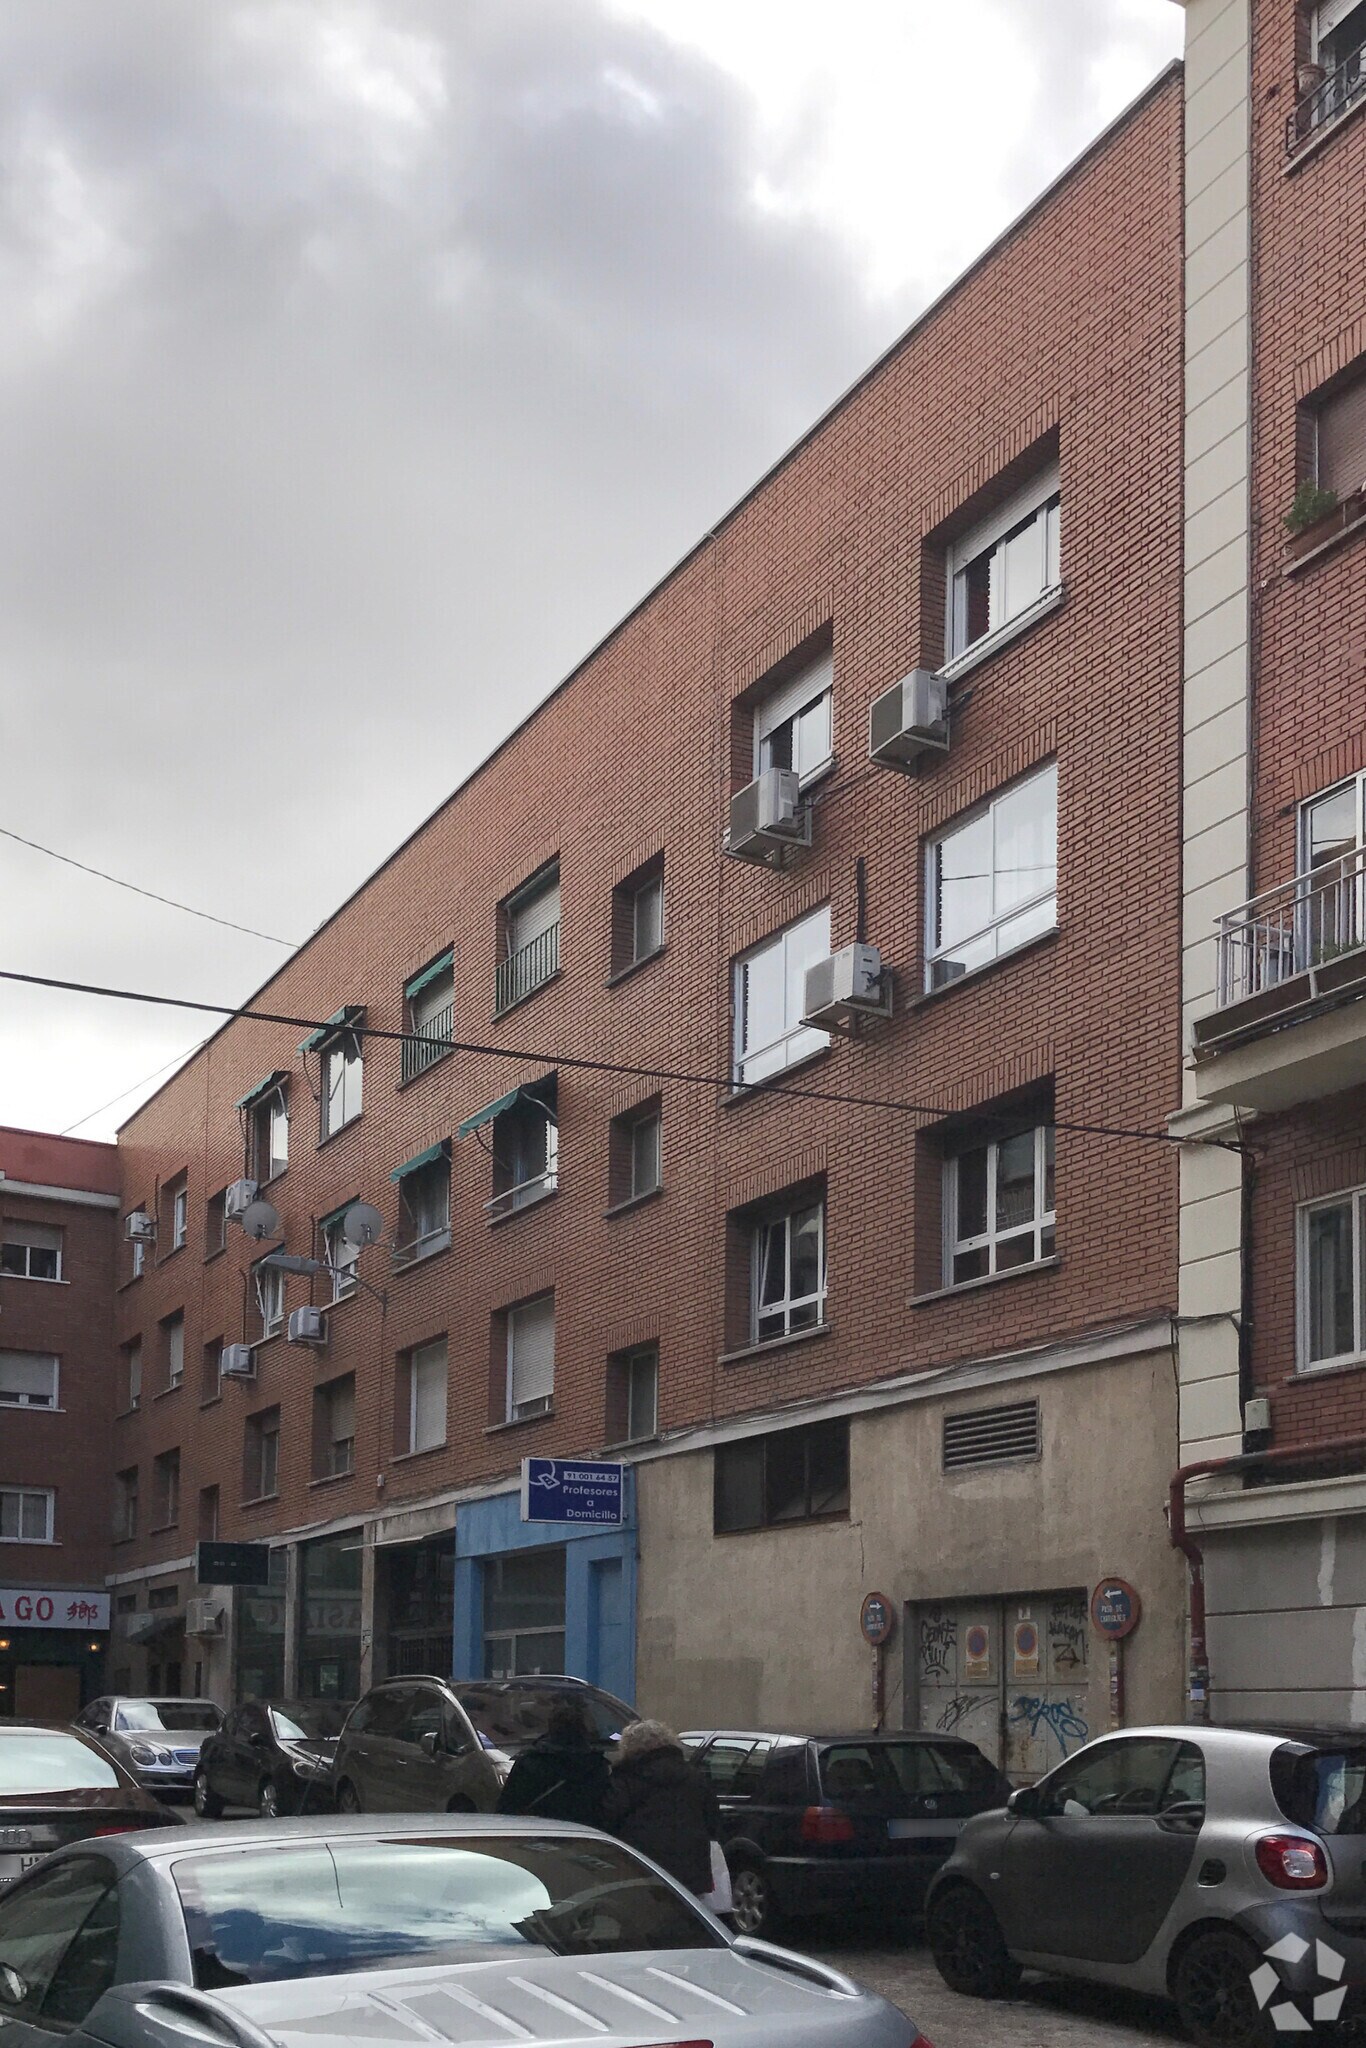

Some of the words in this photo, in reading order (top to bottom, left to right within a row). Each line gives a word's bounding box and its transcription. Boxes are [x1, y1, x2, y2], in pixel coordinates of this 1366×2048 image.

[563, 1485, 618, 1496] Profesores
[586, 1499, 594, 1507] a
[566, 1509, 617, 1519] Domicilio
